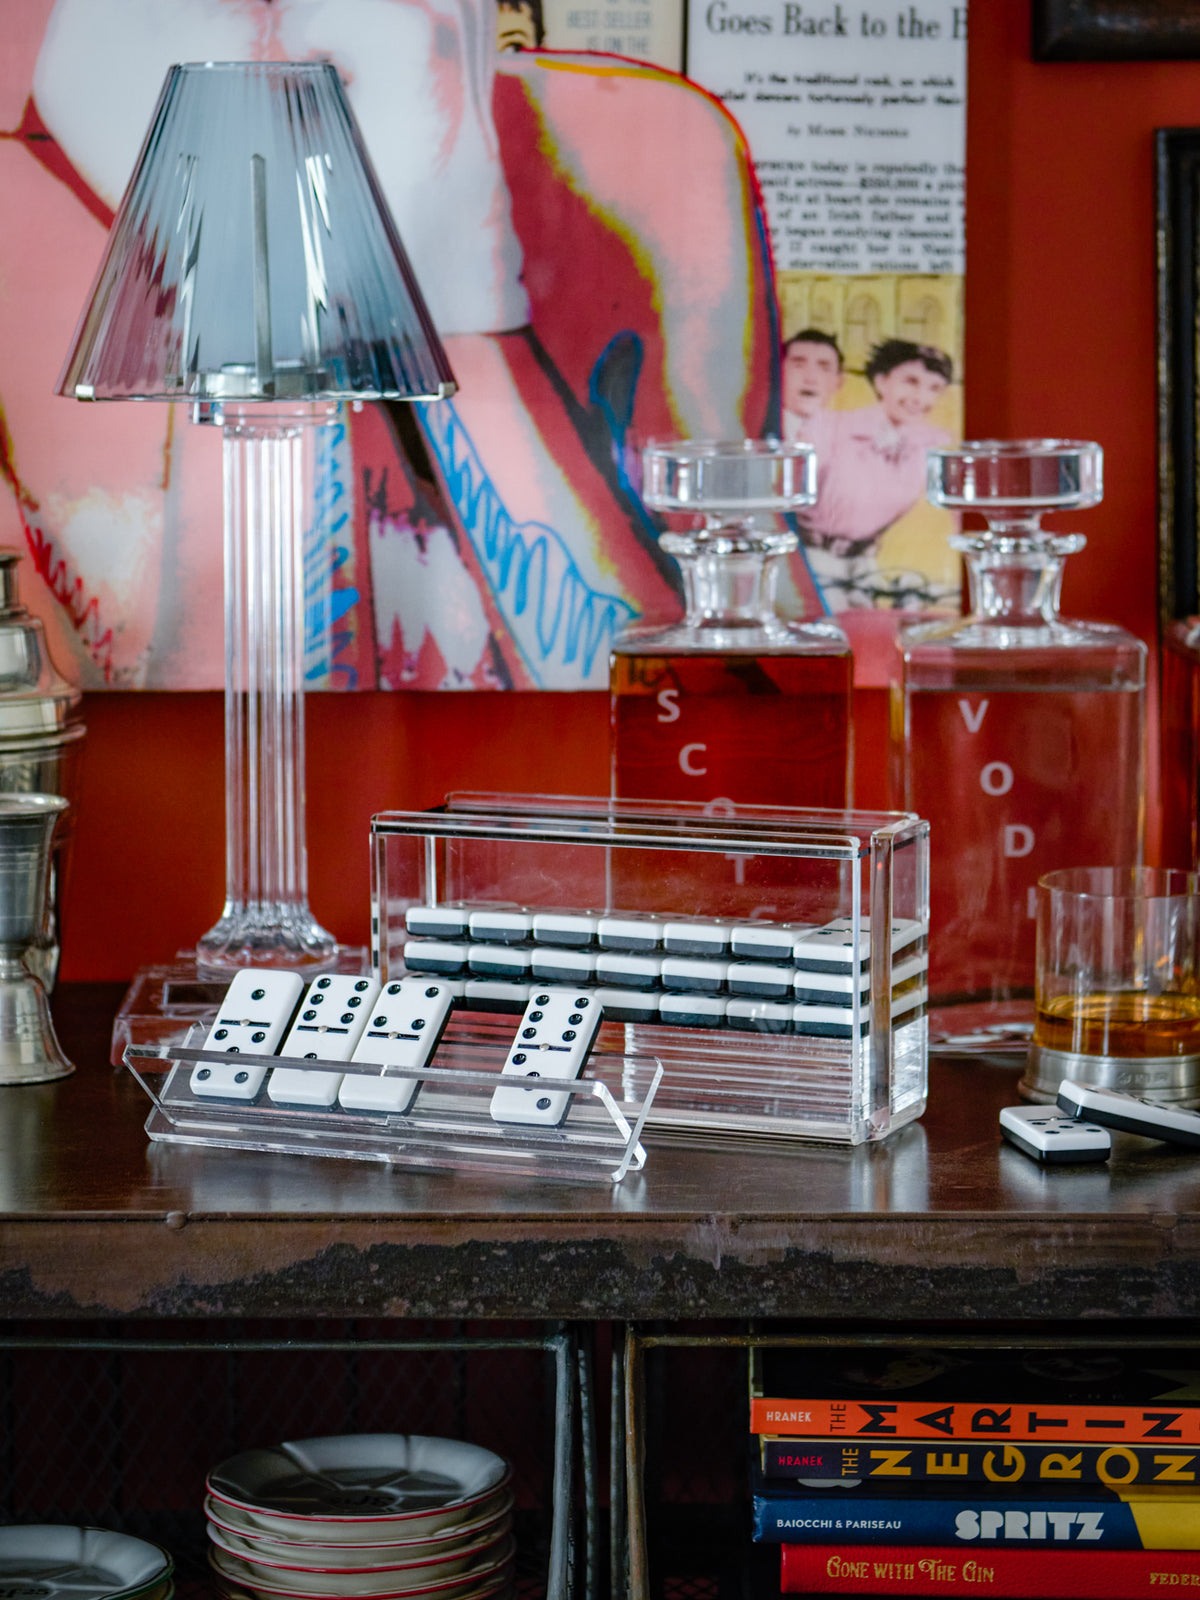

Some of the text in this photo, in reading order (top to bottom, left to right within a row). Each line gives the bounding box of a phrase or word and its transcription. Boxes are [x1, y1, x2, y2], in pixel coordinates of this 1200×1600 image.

[706, 0, 773, 34] Goes
[784, 2, 849, 37] Back
[862, 12, 887, 37] to
[898, 7, 941, 39] the
[766, 1411, 812, 1423] HRANEK
[829, 1403, 1200, 1439] THE MARTIN
[778, 1456, 823, 1467] HRANEK
[841, 1445, 1197, 1486] THE NEGRON
[776, 1519, 902, 1530] BAIOCCHI & PARISEAU
[954, 1509, 1105, 1541] SPRITZ
[1149, 1572, 1200, 1586] FEDER
